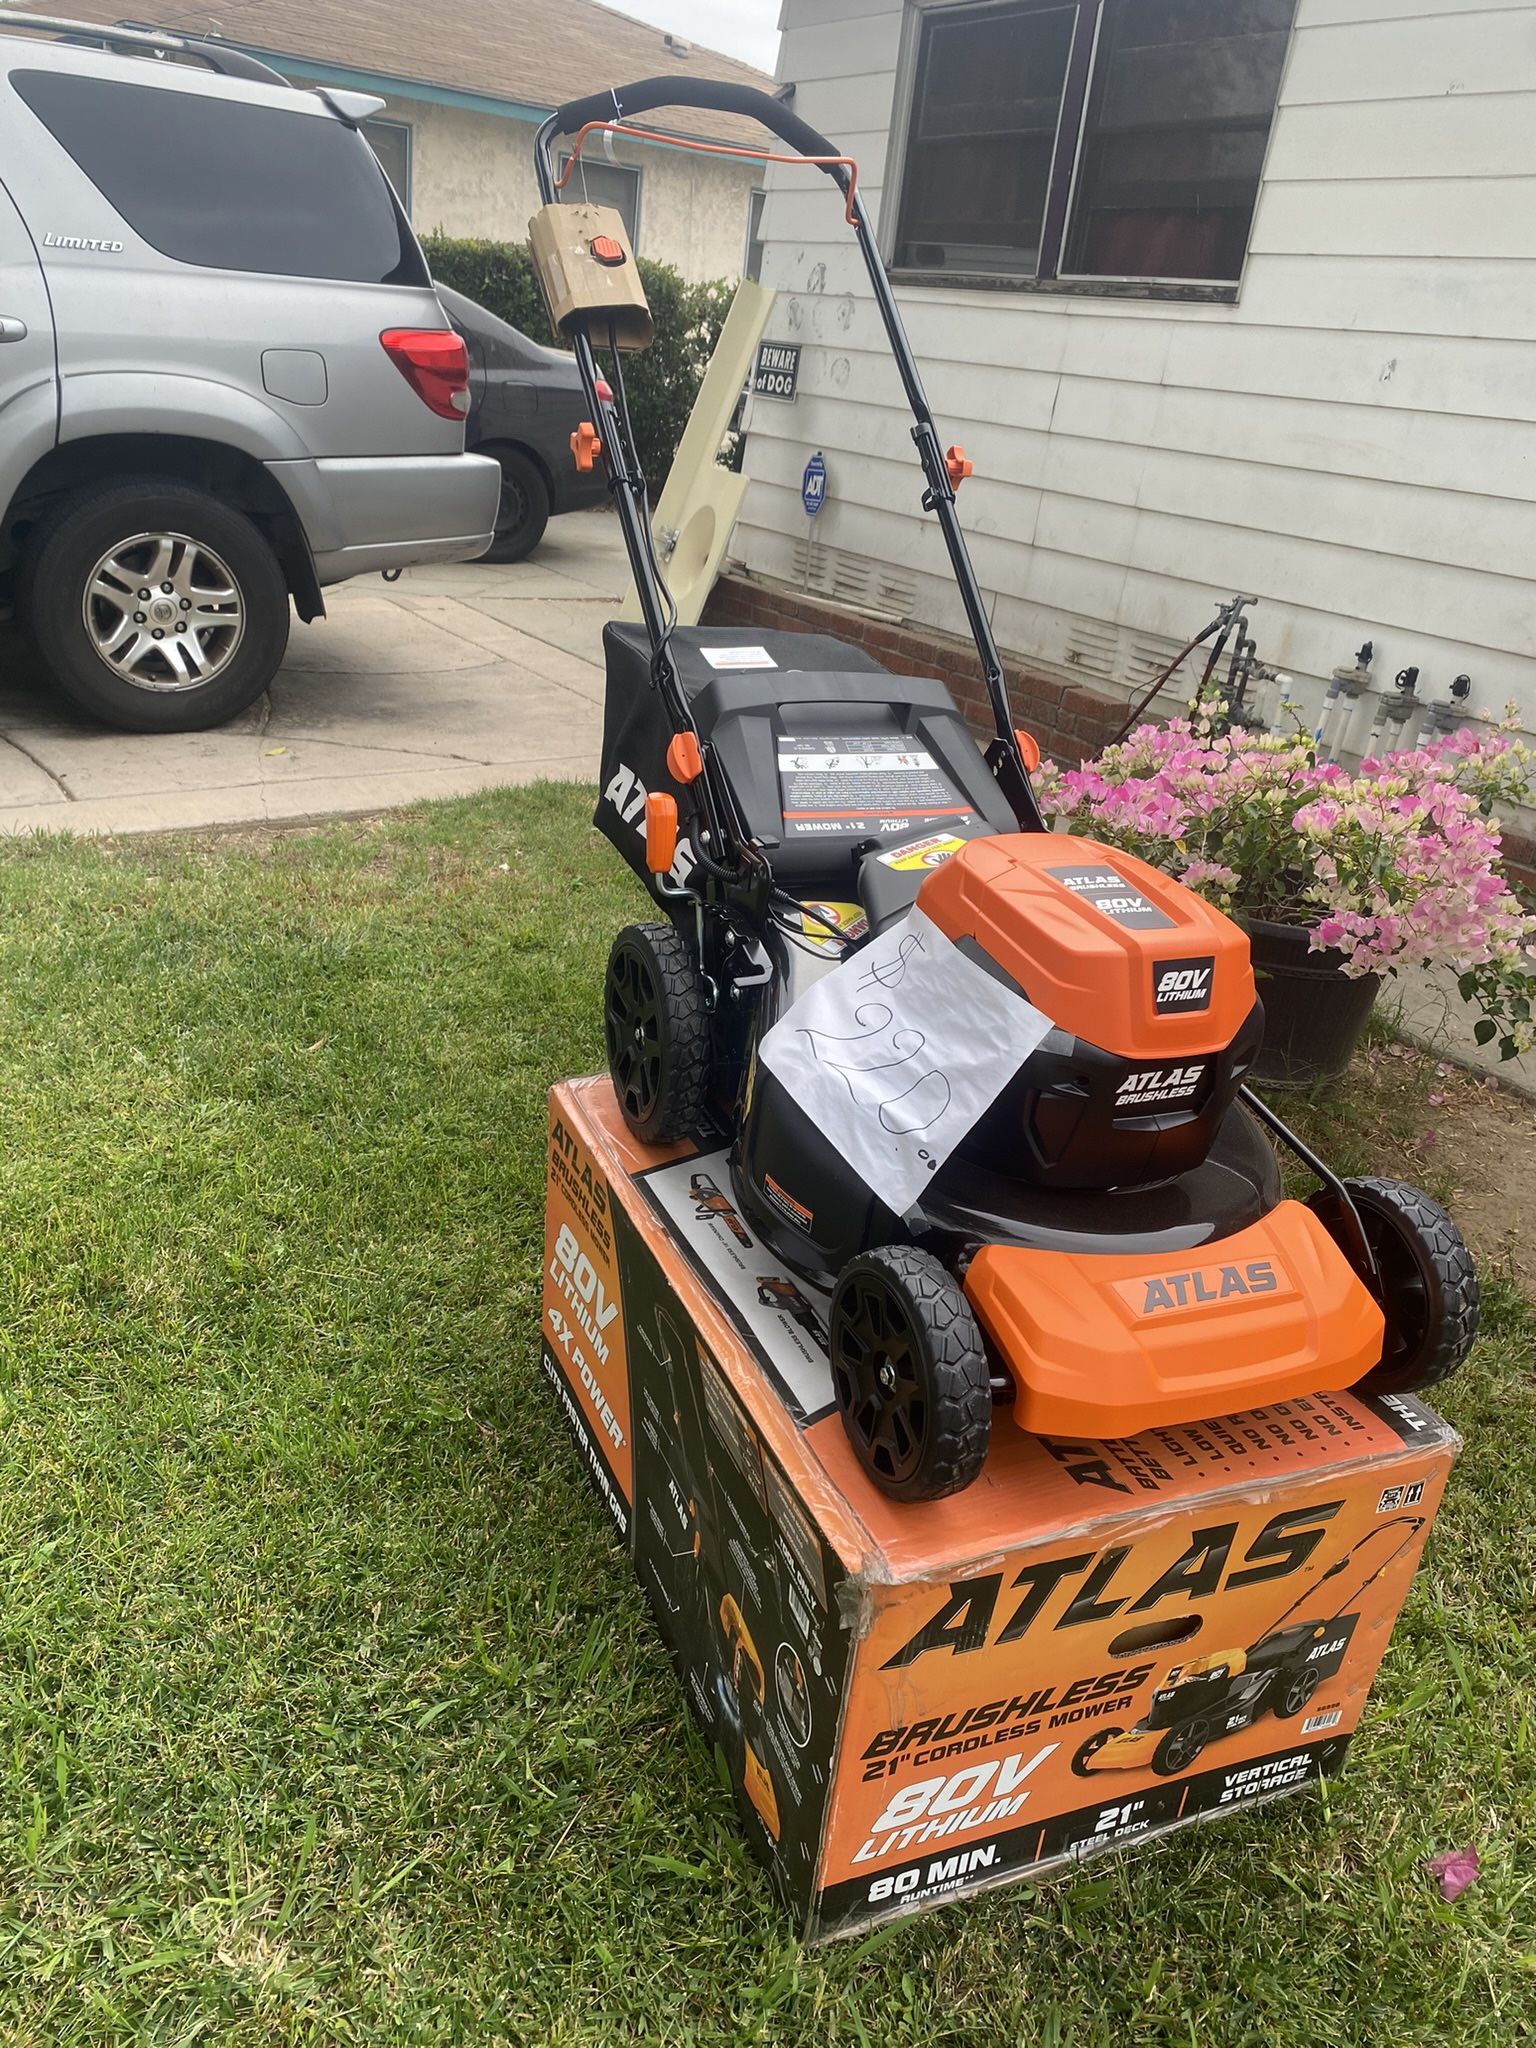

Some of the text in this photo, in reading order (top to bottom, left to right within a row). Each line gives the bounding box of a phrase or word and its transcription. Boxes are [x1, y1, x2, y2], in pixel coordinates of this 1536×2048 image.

[760, 347, 796, 371] BEWARE
[757, 374, 793, 394] of DOG
[805, 474, 824, 497] ADT
[604, 763, 698, 889] ATS
[795, 821, 842, 831] MOWER
[890, 837, 943, 859] DANGER
[1063, 875, 1121, 886] ATLAS
[1069, 883, 1126, 891] BRUSHLESS
[1096, 897, 1143, 910] 80V
[1103, 906, 1152, 915] LITHIUM
[1156, 988, 1207, 1003] LITHIUM
[1157, 968, 1211, 992] 80V
[1115, 1065, 1206, 1094] ATLAS
[1115, 1084, 1197, 1107] BRUSHLESS
[551, 1118, 607, 1216] ATLAS
[551, 1149, 611, 1250] BRUSHLESS
[555, 1223, 619, 1331] 80V
[1143, 1261, 1278, 1314] ATLAS
[549, 1257, 610, 1366] LITHIUM
[777, 1314, 795, 1336] BLOWER
[548, 1307, 574, 1355] 4X
[1289, 1419, 1320, 1441] NO
[1312, 1414, 1343, 1437] NO
[1377, 1394, 1428, 1432] THE
[543, 1353, 627, 1534] CUTS FASTER THAN GAS
[1151, 1428, 1198, 1466] LIGH
[1182, 1428, 1225, 1461] LOW
[1203, 1420, 1248, 1455] QUIE
[1242, 1429, 1273, 1451] NO
[1265, 1423, 1296, 1446] NO
[1099, 1439, 1161, 1490] BATTE
[1120, 1439, 1174, 1480] BETT
[668, 1479, 689, 1531] ATLAS
[878, 1499, 1347, 1671] ATLAS
[1305, 1636, 1347, 1664] ATLAS
[860, 1661, 1158, 1760] BRUSHLESS
[862, 1695, 1133, 1782] 21" CORDLESS MOWER
[1219, 1766, 1309, 1804] STORAGE
[1223, 1752, 1313, 1789] VERTICAL
[870, 1742, 1062, 1835] 80V
[850, 1791, 1030, 1865] LITHIUM
[1094, 1799, 1145, 1833] 21"
[1069, 1818, 1150, 1853] STEEL DECK
[867, 1844, 1001, 1903] 80 MIN.
